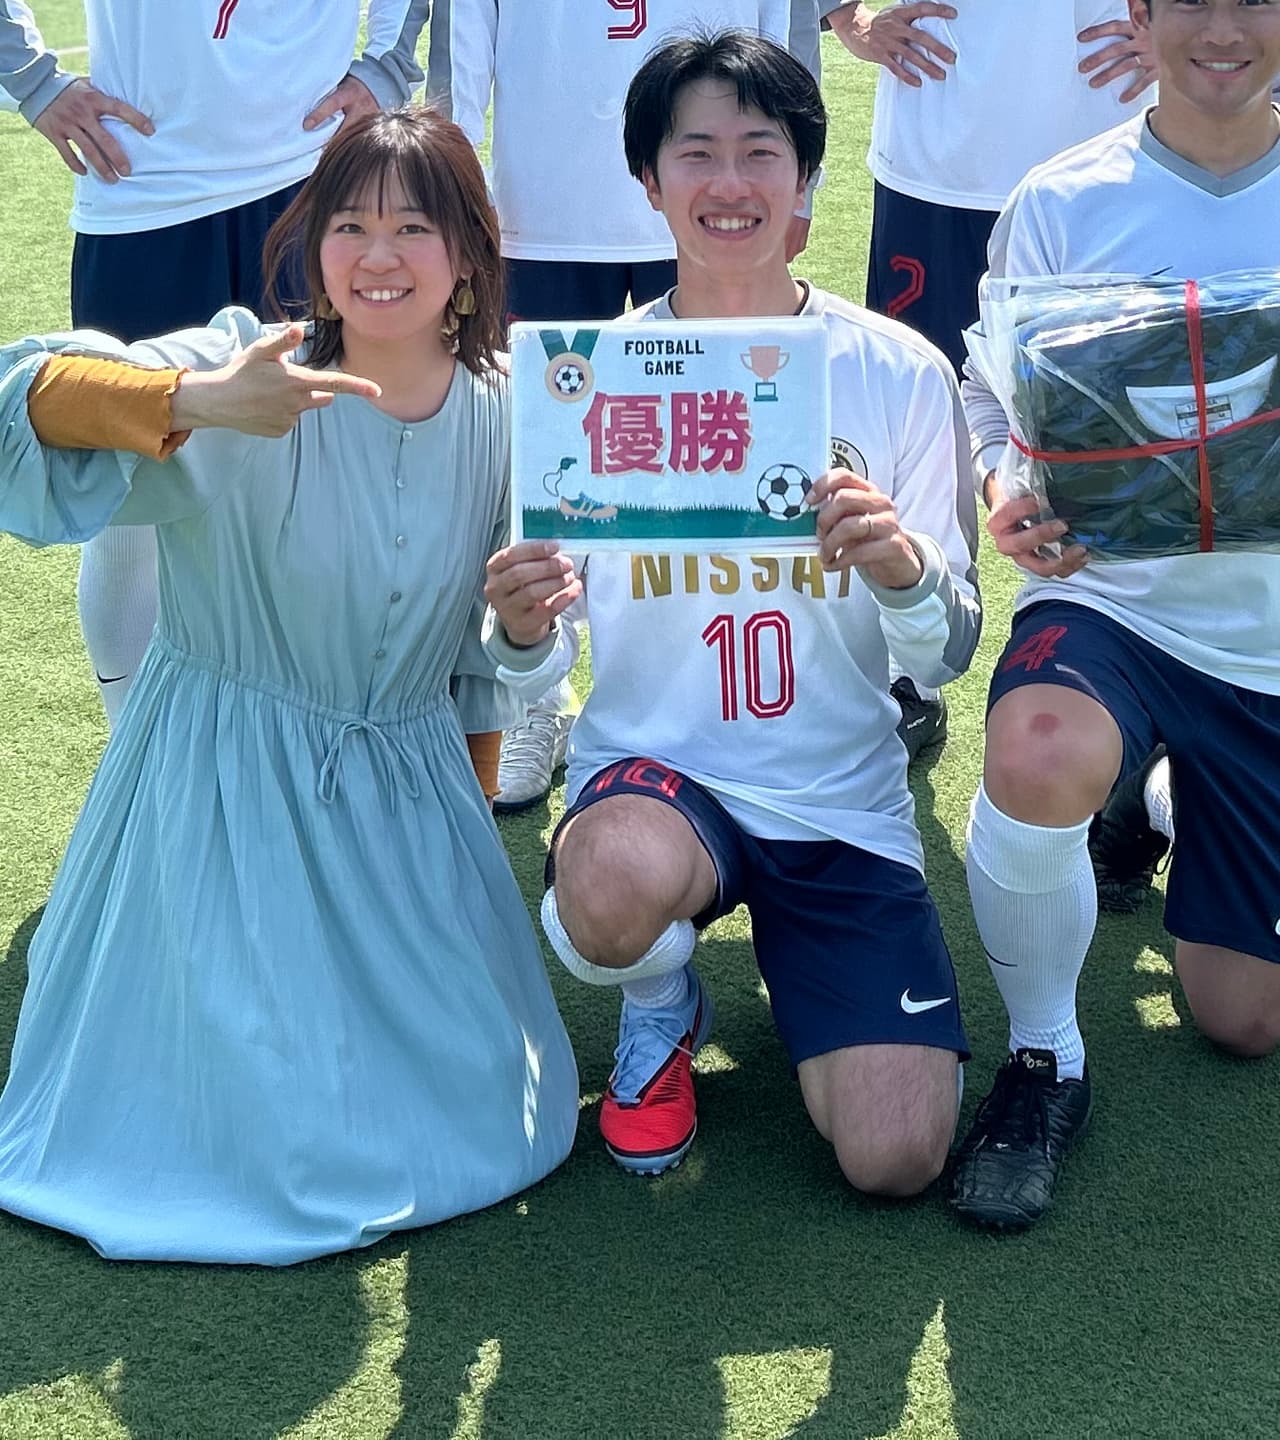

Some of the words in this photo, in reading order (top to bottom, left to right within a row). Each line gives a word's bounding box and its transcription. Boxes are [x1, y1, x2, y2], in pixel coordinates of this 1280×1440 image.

[624, 340, 705, 356] FOOTBALL
[644, 361, 685, 376] GAME
[582, 389, 752, 474] 優勝
[701, 610, 795, 721] 10
[1001, 625, 1068, 672] 4
